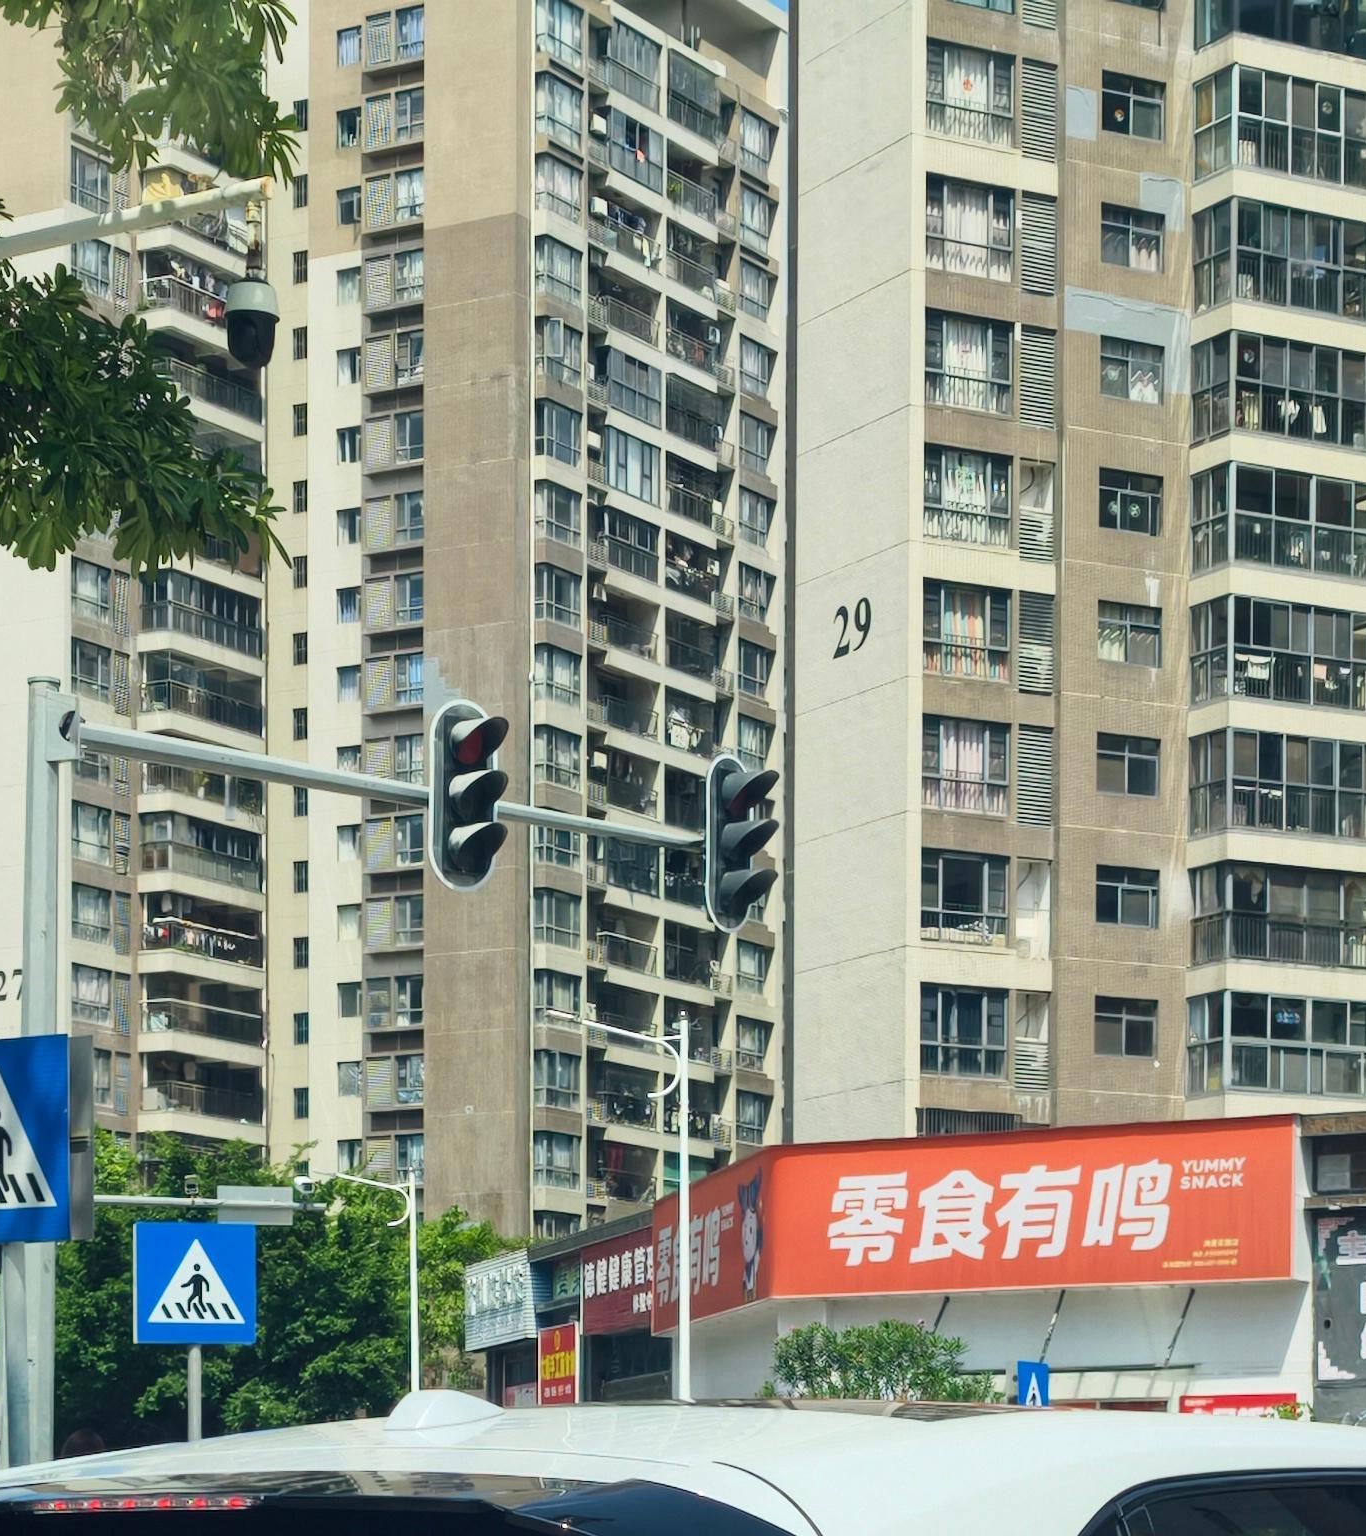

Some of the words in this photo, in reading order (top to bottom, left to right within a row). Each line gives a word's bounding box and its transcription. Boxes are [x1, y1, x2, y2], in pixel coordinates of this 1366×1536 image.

[832, 597, 872, 660] 29
[1180, 1173, 1244, 1190] SNACK
[1181, 1157, 1247, 1174] YUMMY
[827, 1158, 1173, 1267] 零食有鸣
